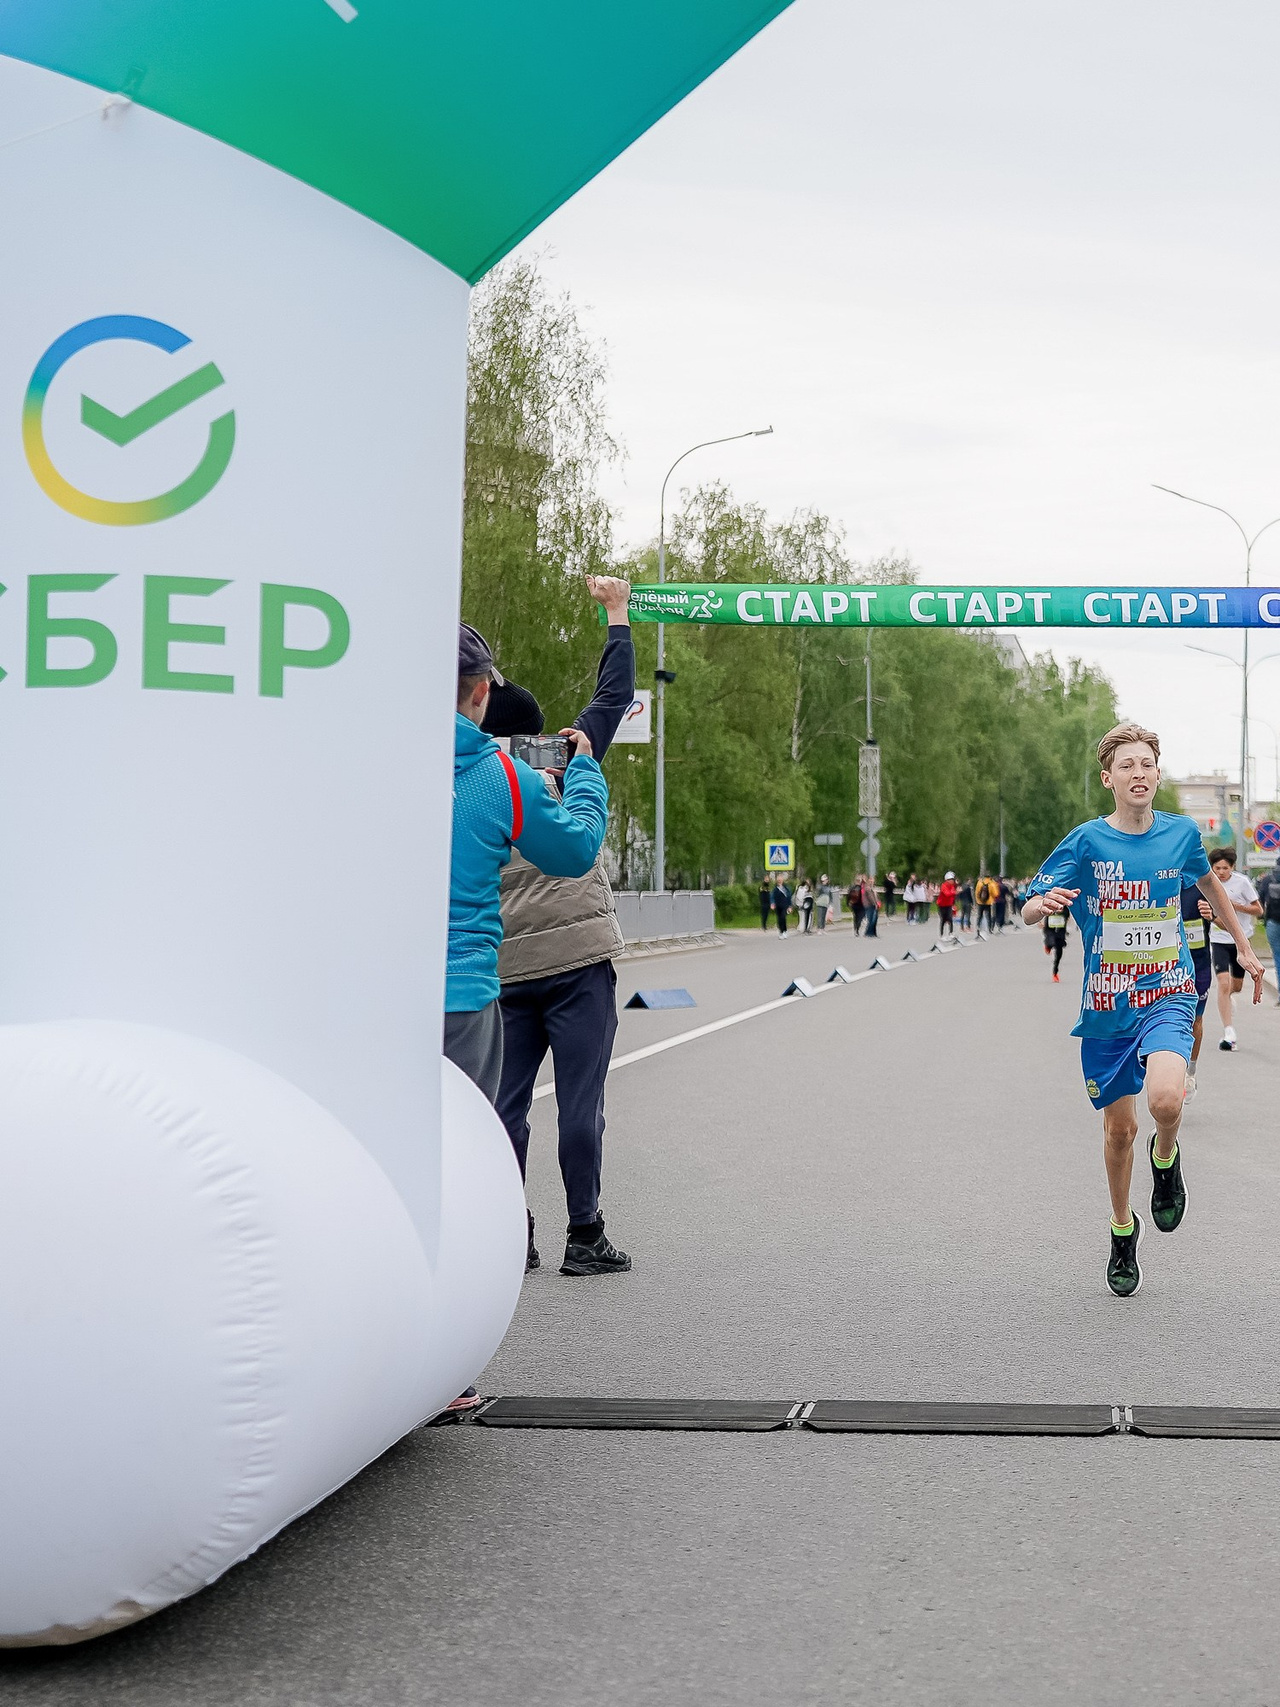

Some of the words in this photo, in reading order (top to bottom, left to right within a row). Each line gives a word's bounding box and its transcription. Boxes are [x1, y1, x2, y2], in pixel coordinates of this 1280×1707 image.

[630, 590, 689, 604] елёный
[629, 600, 686, 615] арафон
[736, 591, 877, 623] СТАРТ
[909, 592, 1051, 623] СТАРТ
[1083, 592, 1226, 624] СТАРТ
[0, 573, 351, 698] БЕР
[1091, 861, 1125, 880] 2024
[1098, 880, 1150, 900] #МЕЧТА
[1124, 931, 1162, 946] 3119
[1084, 991, 1116, 1011] АБЕГ
